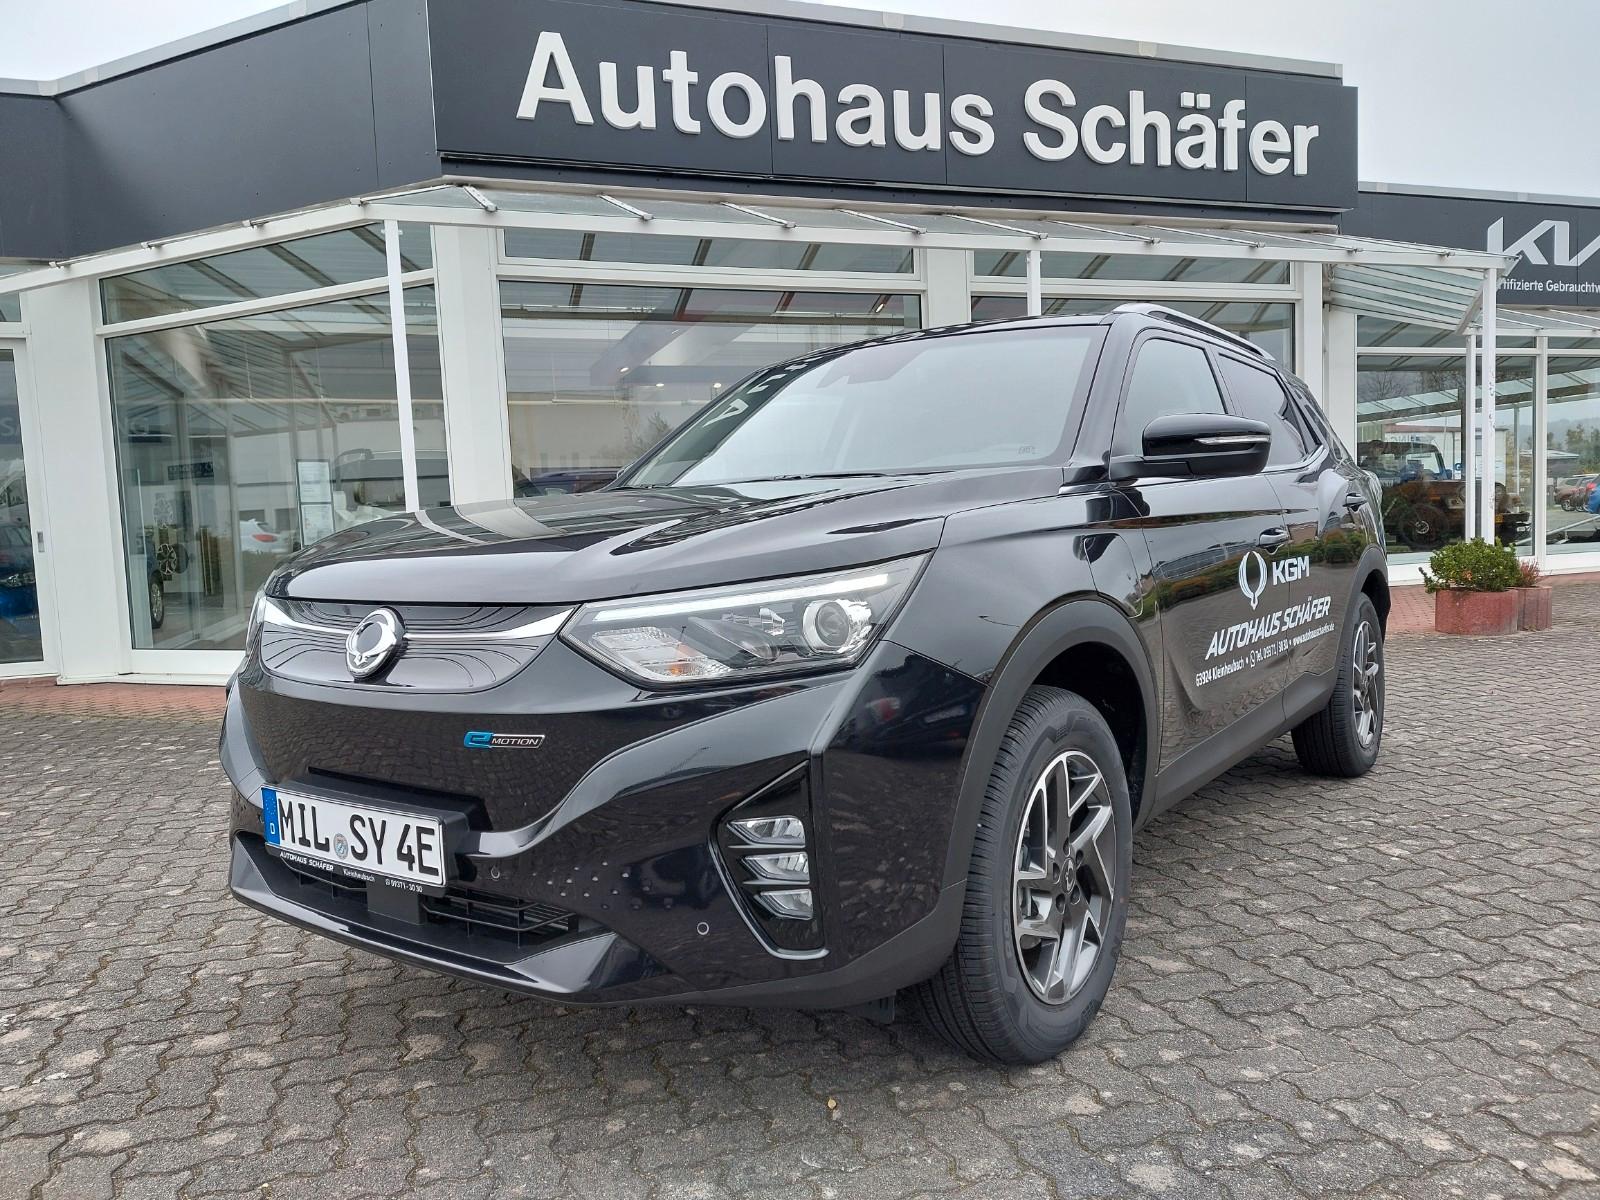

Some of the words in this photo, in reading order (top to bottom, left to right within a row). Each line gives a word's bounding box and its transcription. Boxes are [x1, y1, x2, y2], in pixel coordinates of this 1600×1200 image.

[516, 30, 995, 156] Autohaus
[1023, 79, 1320, 176] Schäfer
[1272, 555, 1310, 586] KGM
[1204, 610, 1282, 660] AUTOHAUS
[1281, 596, 1332, 632] SCHÄFER
[1195, 668, 1212, 687] 63924
[269, 822, 276, 835] D
[278, 798, 330, 853] MIL
[349, 813, 387, 865] SY
[397, 823, 439, 877] 4E
[279, 851, 307, 865] AUTOHAUS
[308, 858, 334, 872] SCHÄFER
